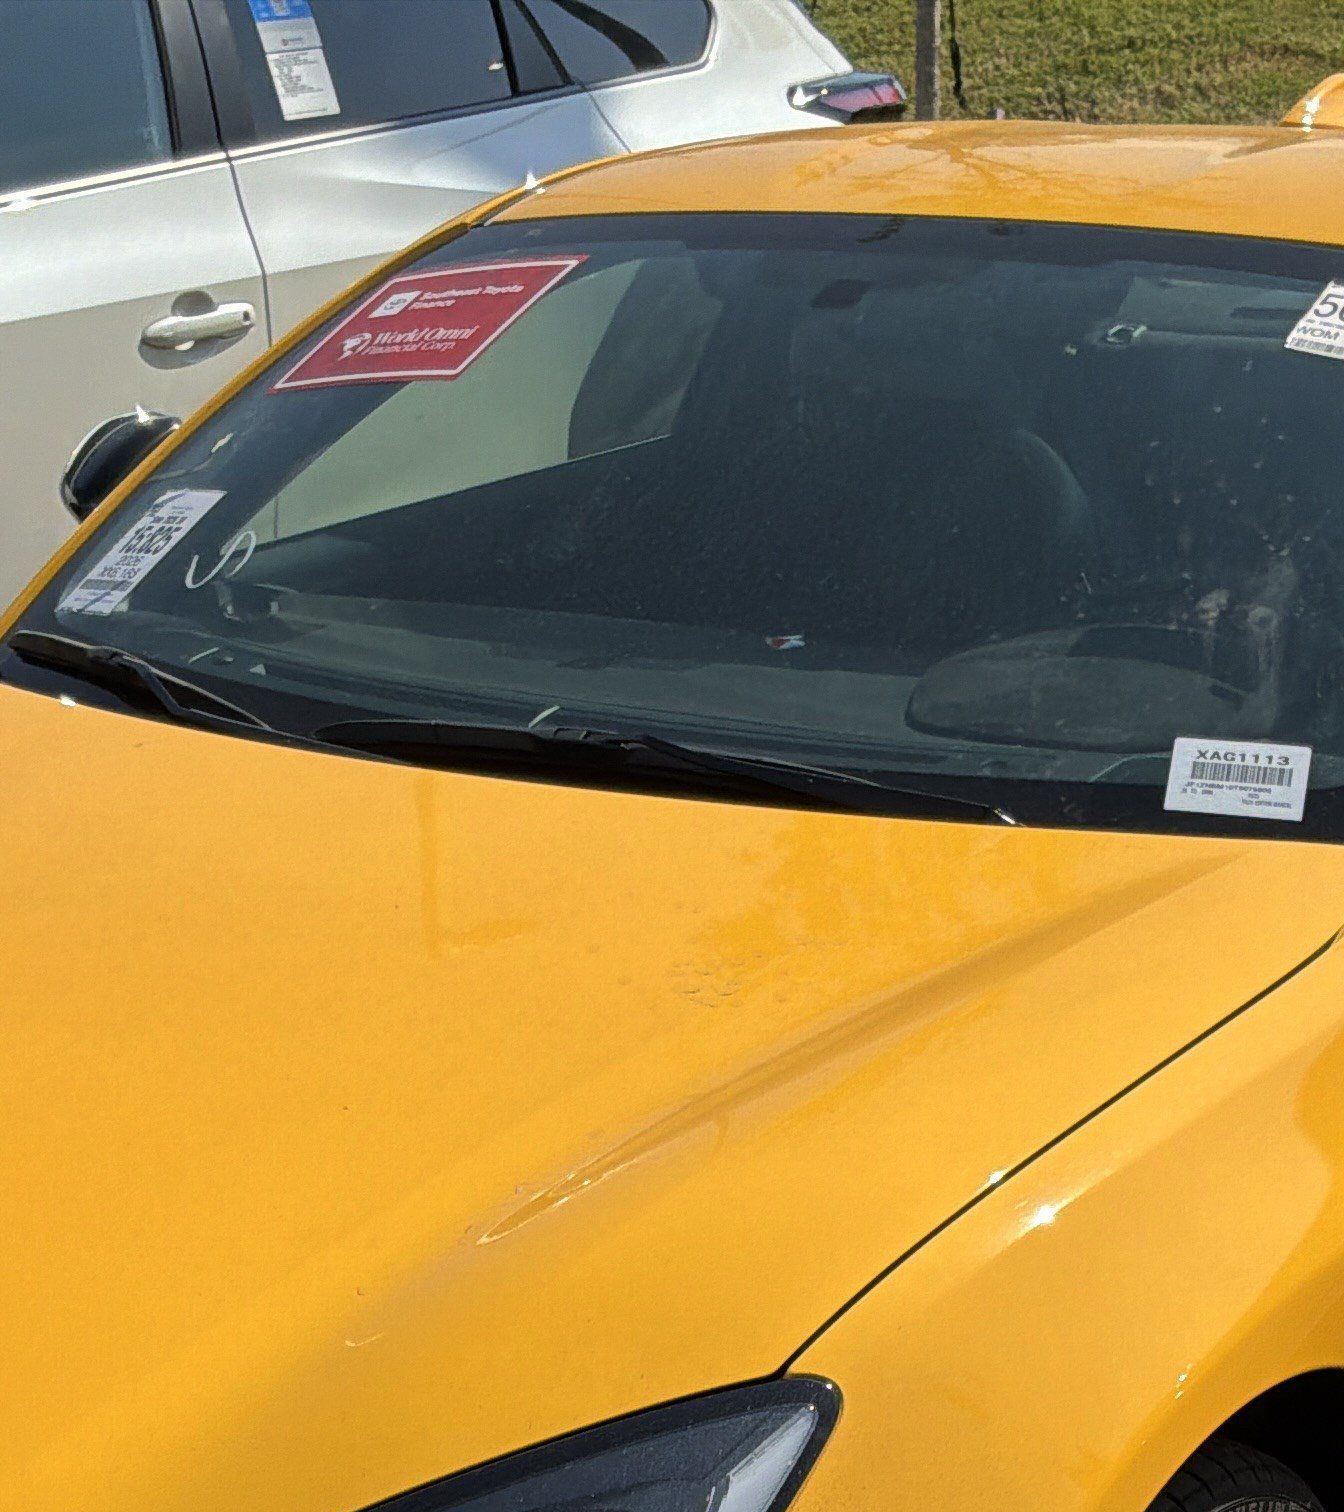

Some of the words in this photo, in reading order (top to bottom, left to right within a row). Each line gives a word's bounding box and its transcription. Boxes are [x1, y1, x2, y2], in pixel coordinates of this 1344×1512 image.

[373, 328, 422, 345] World
[422, 325, 479, 341] Omni
[1295, 326, 1340, 341] WOM
[360, 342, 423, 356] Financial
[423, 341, 456, 353] Corp.
[1196, 749, 1290, 766] XAG1113
